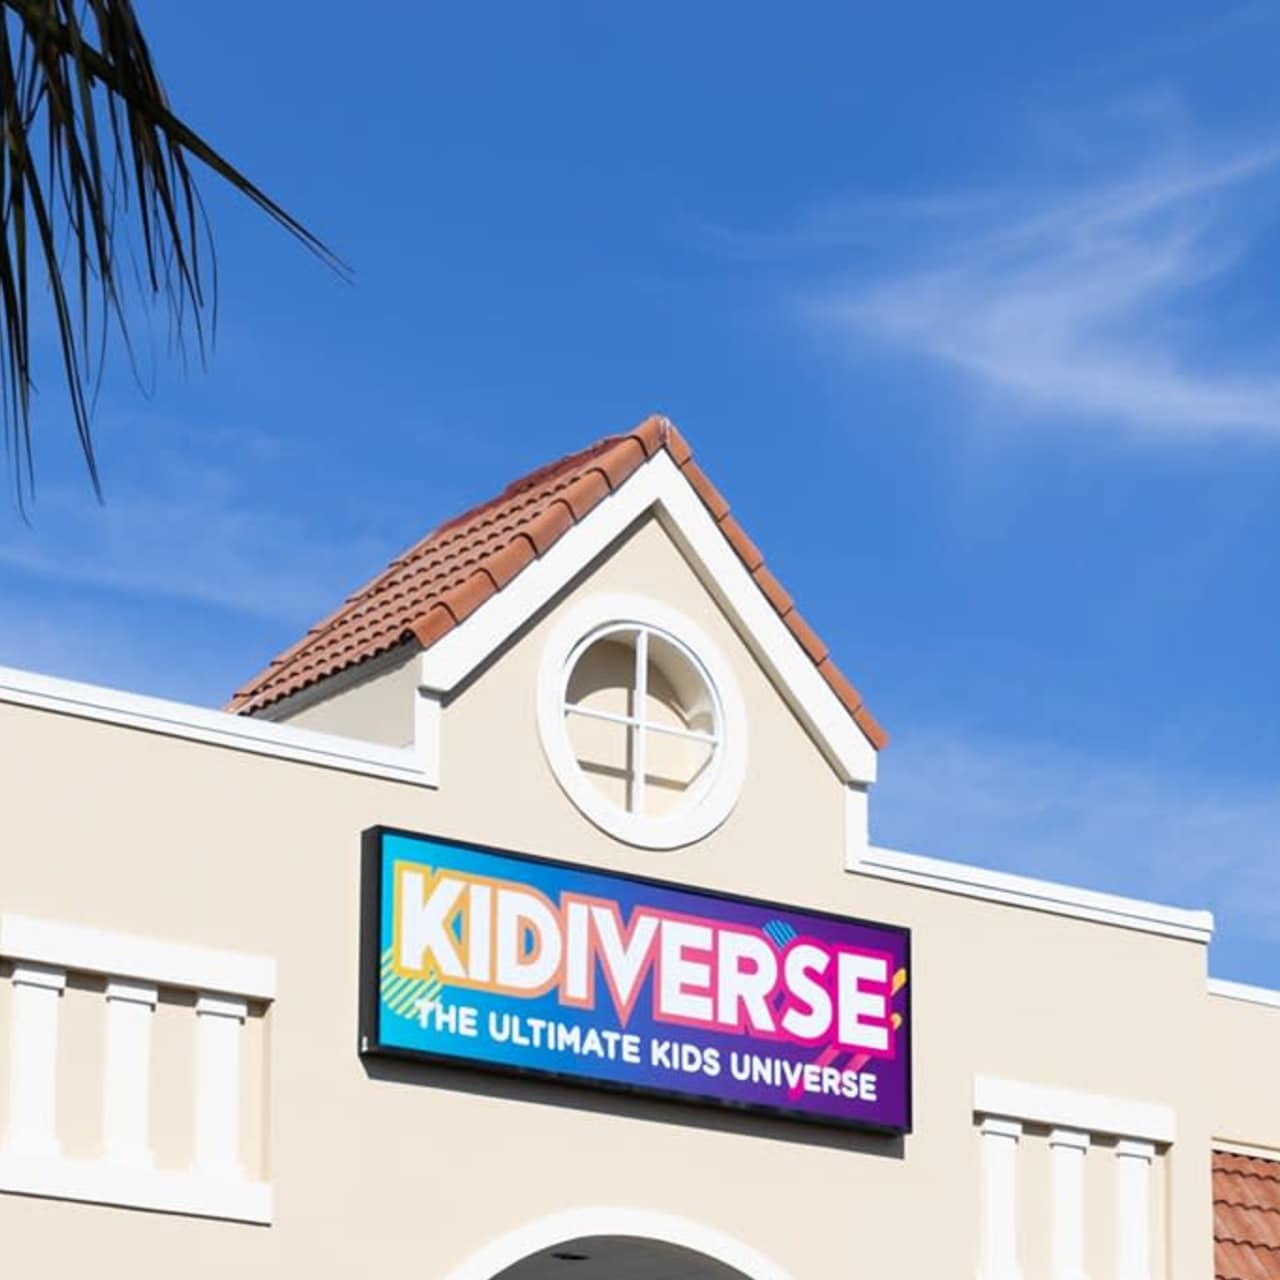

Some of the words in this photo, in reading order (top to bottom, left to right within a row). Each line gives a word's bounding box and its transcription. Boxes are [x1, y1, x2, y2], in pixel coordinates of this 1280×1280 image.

[397, 864, 891, 1055] KIDIVERSE
[413, 998, 478, 1038] THE
[488, 1011, 641, 1064] ULTIMATE
[650, 1038, 721, 1076] KIDS
[730, 1051, 878, 1102] UNIVERSE
